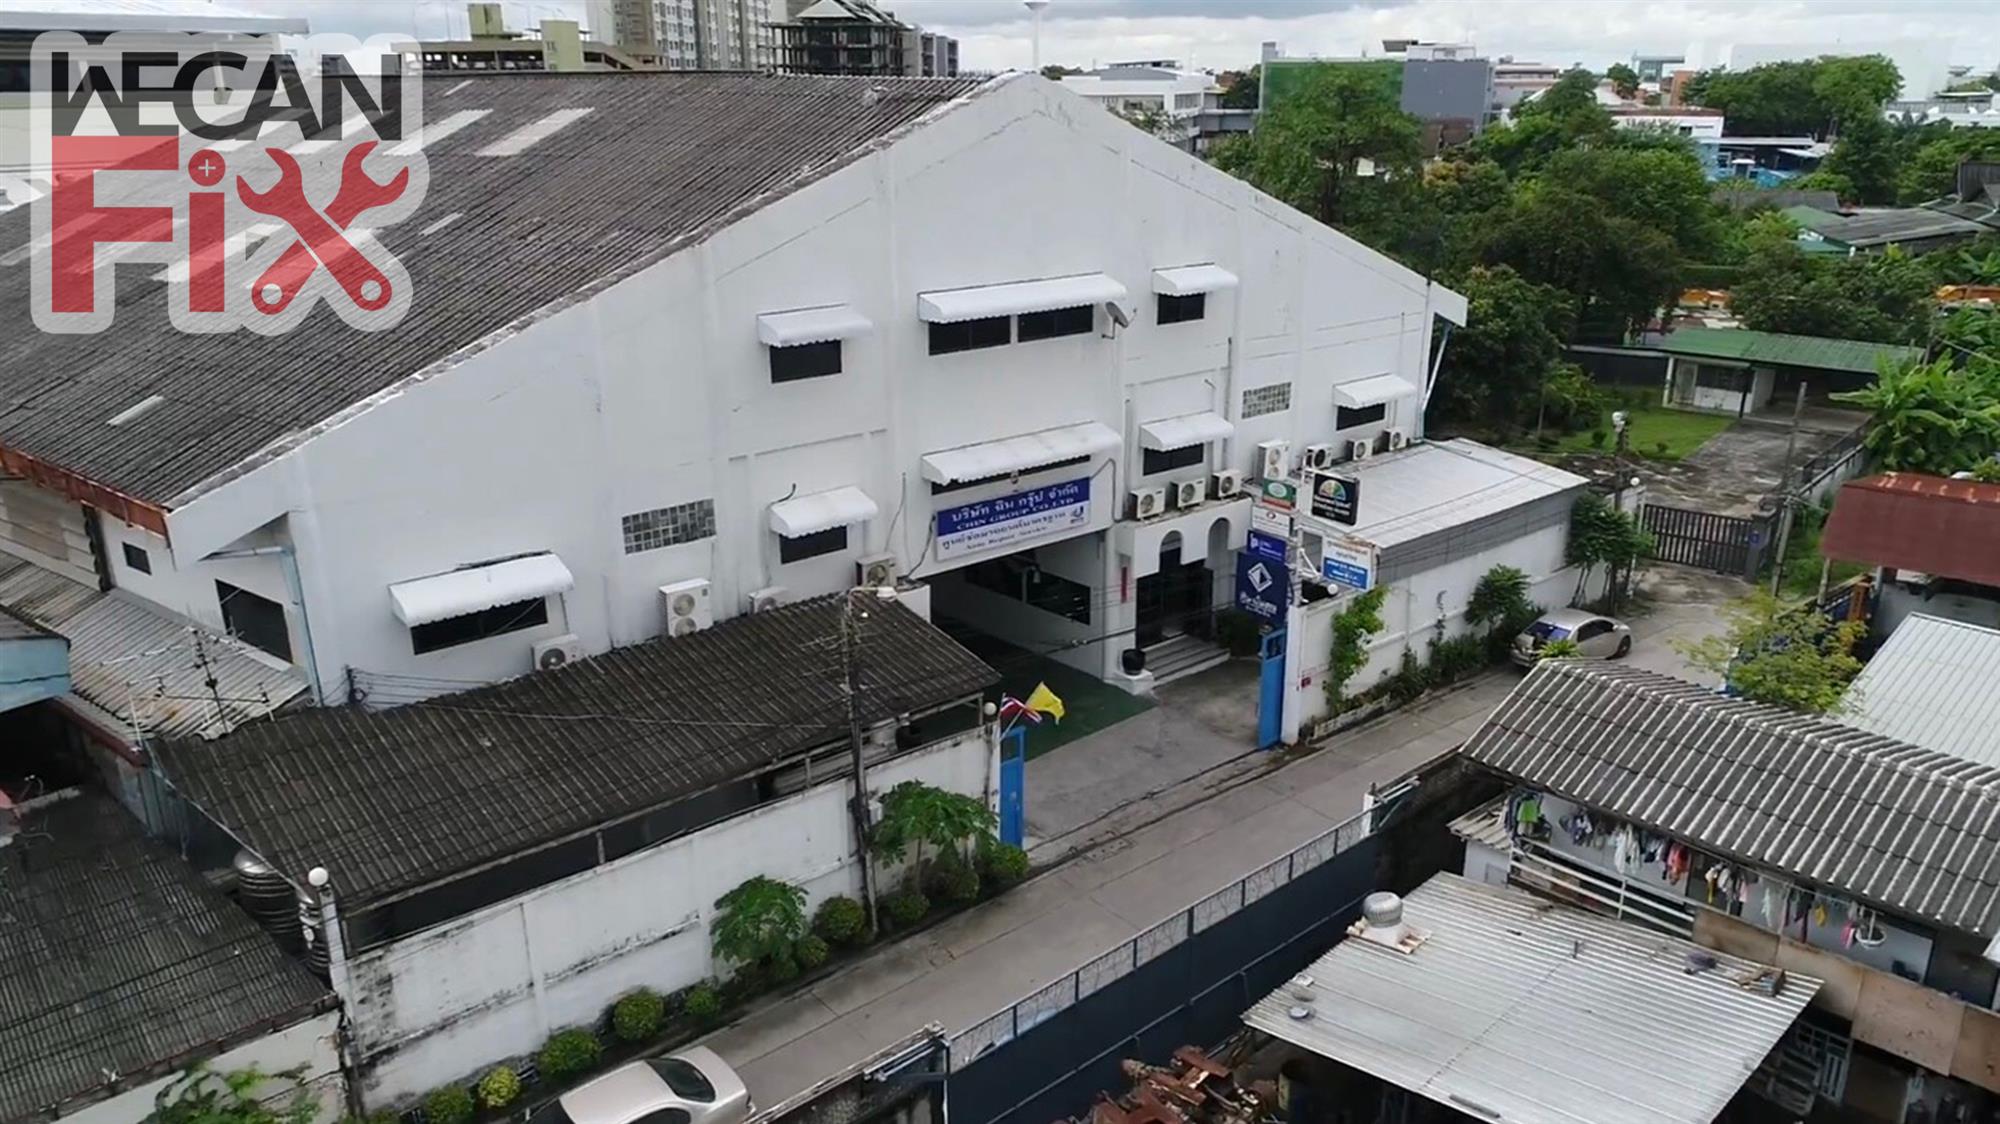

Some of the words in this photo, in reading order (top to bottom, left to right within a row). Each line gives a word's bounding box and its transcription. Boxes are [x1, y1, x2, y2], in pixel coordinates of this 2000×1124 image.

[952, 503, 990, 522] บริษัท
[1049, 484, 1079, 499] จำกัด
[990, 508, 1029, 523] GROUP
